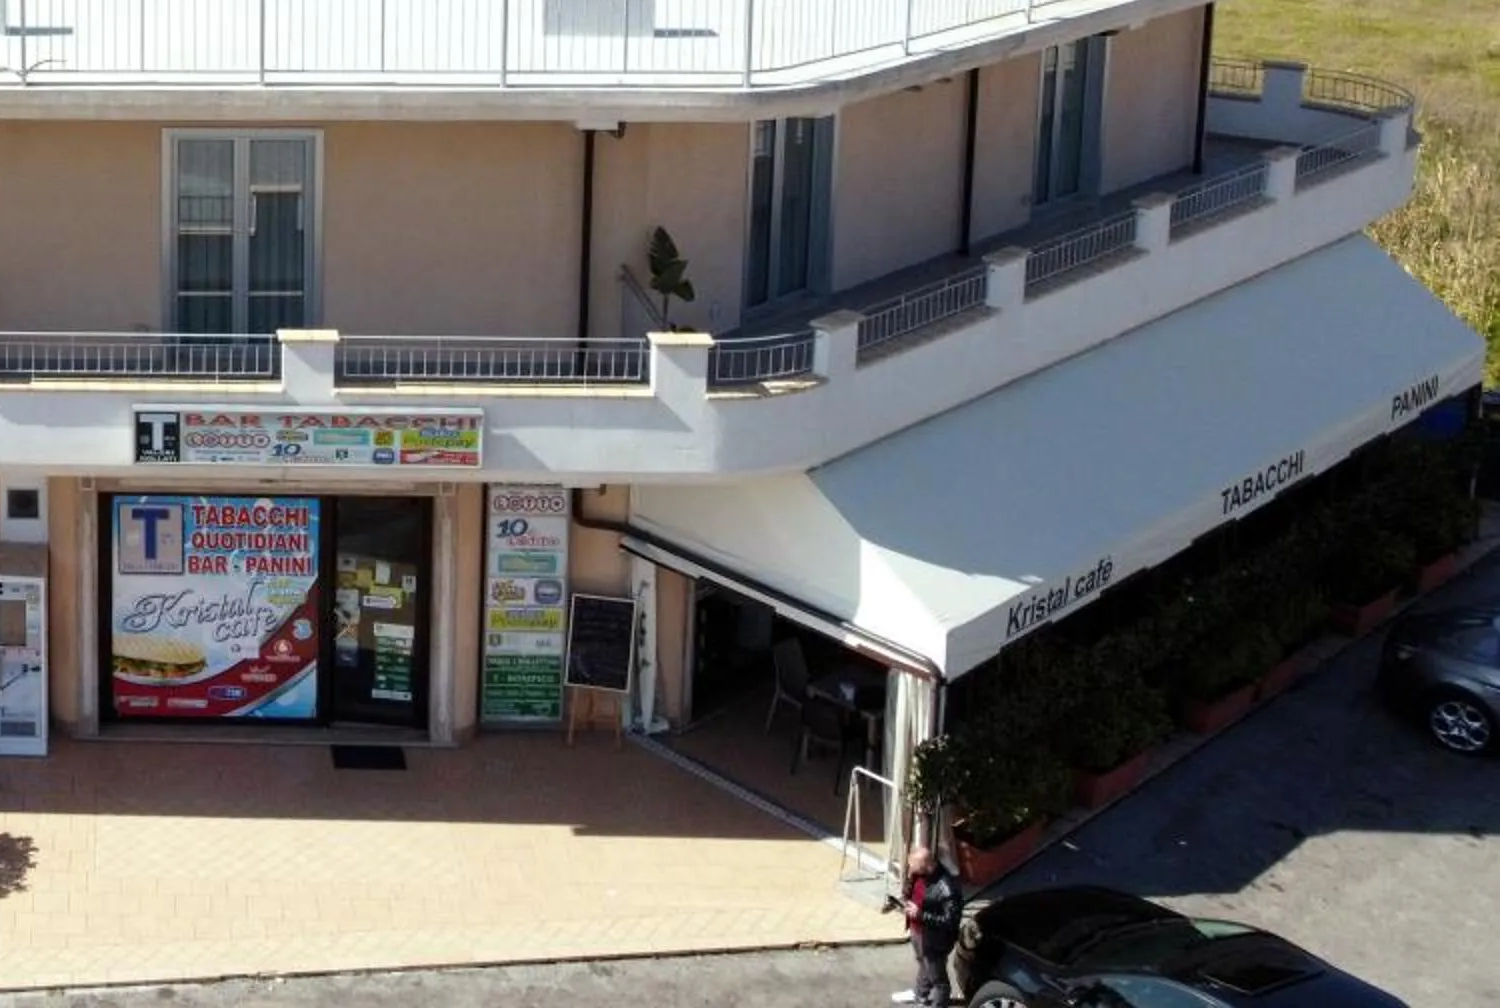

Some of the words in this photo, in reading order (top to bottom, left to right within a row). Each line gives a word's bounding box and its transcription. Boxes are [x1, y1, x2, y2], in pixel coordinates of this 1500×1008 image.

[1391, 374, 1439, 421] PANINI
[140, 413, 177, 450] T
[185, 414, 262, 428] BAR
[277, 414, 477, 428] TABACCHI
[1221, 449, 1305, 515] TABACCHI
[132, 508, 170, 560] T
[191, 505, 308, 528] TABACCHI
[496, 518, 528, 539] 10
[191, 532, 308, 552] QUOTIDIANI
[188, 555, 229, 575] BAR
[245, 556, 312, 576] PANINI
[122, 580, 264, 634] Kristal
[1006, 575, 1071, 637] Kristal
